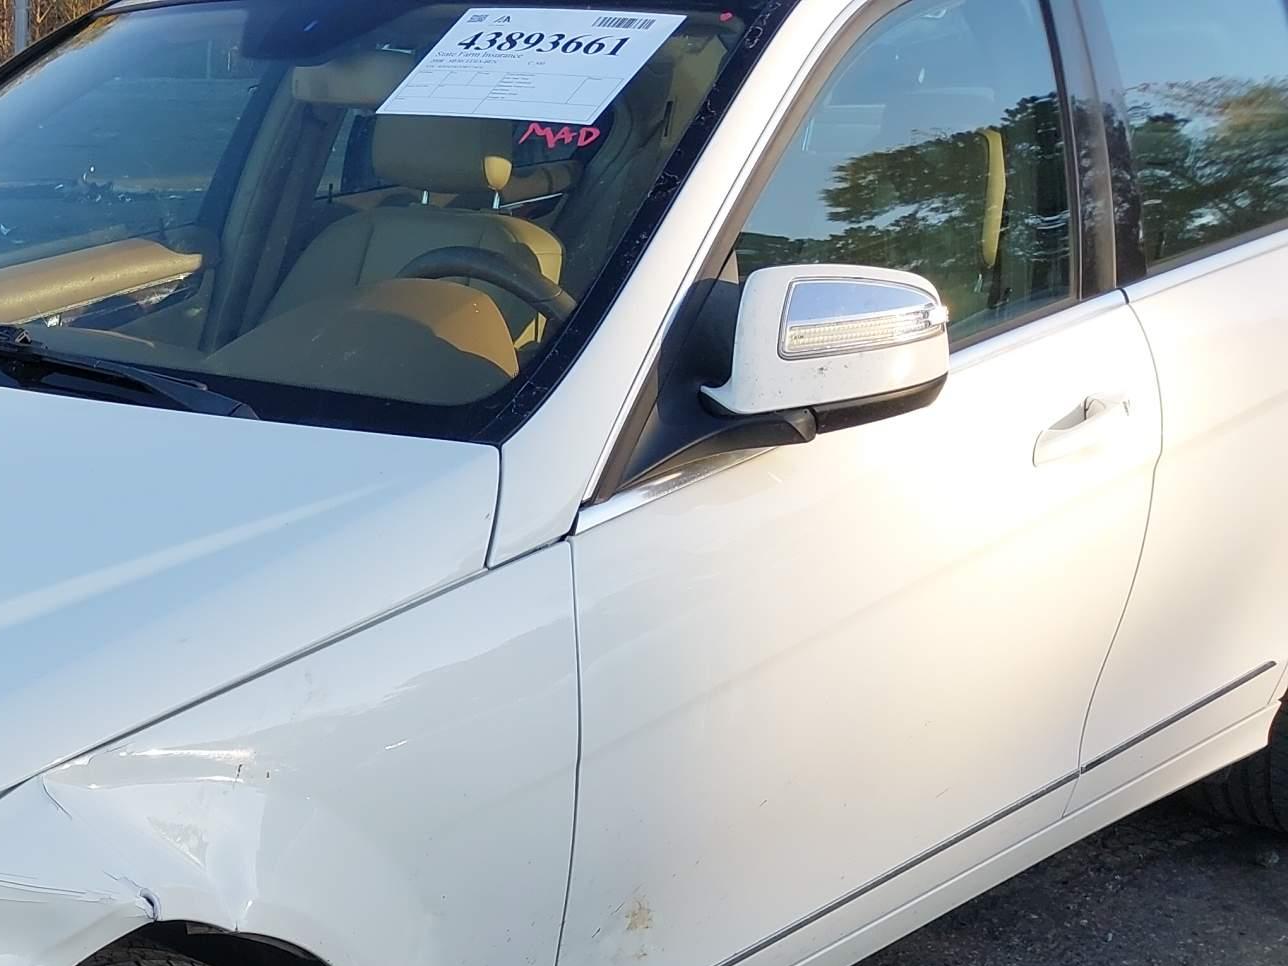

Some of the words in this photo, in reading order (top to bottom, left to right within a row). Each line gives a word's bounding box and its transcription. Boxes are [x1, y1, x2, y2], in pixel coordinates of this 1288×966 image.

[457, 31, 631, 56] 43893661
[482, 51, 524, 59] Insurance
[518, 122, 601, 149] MAD
